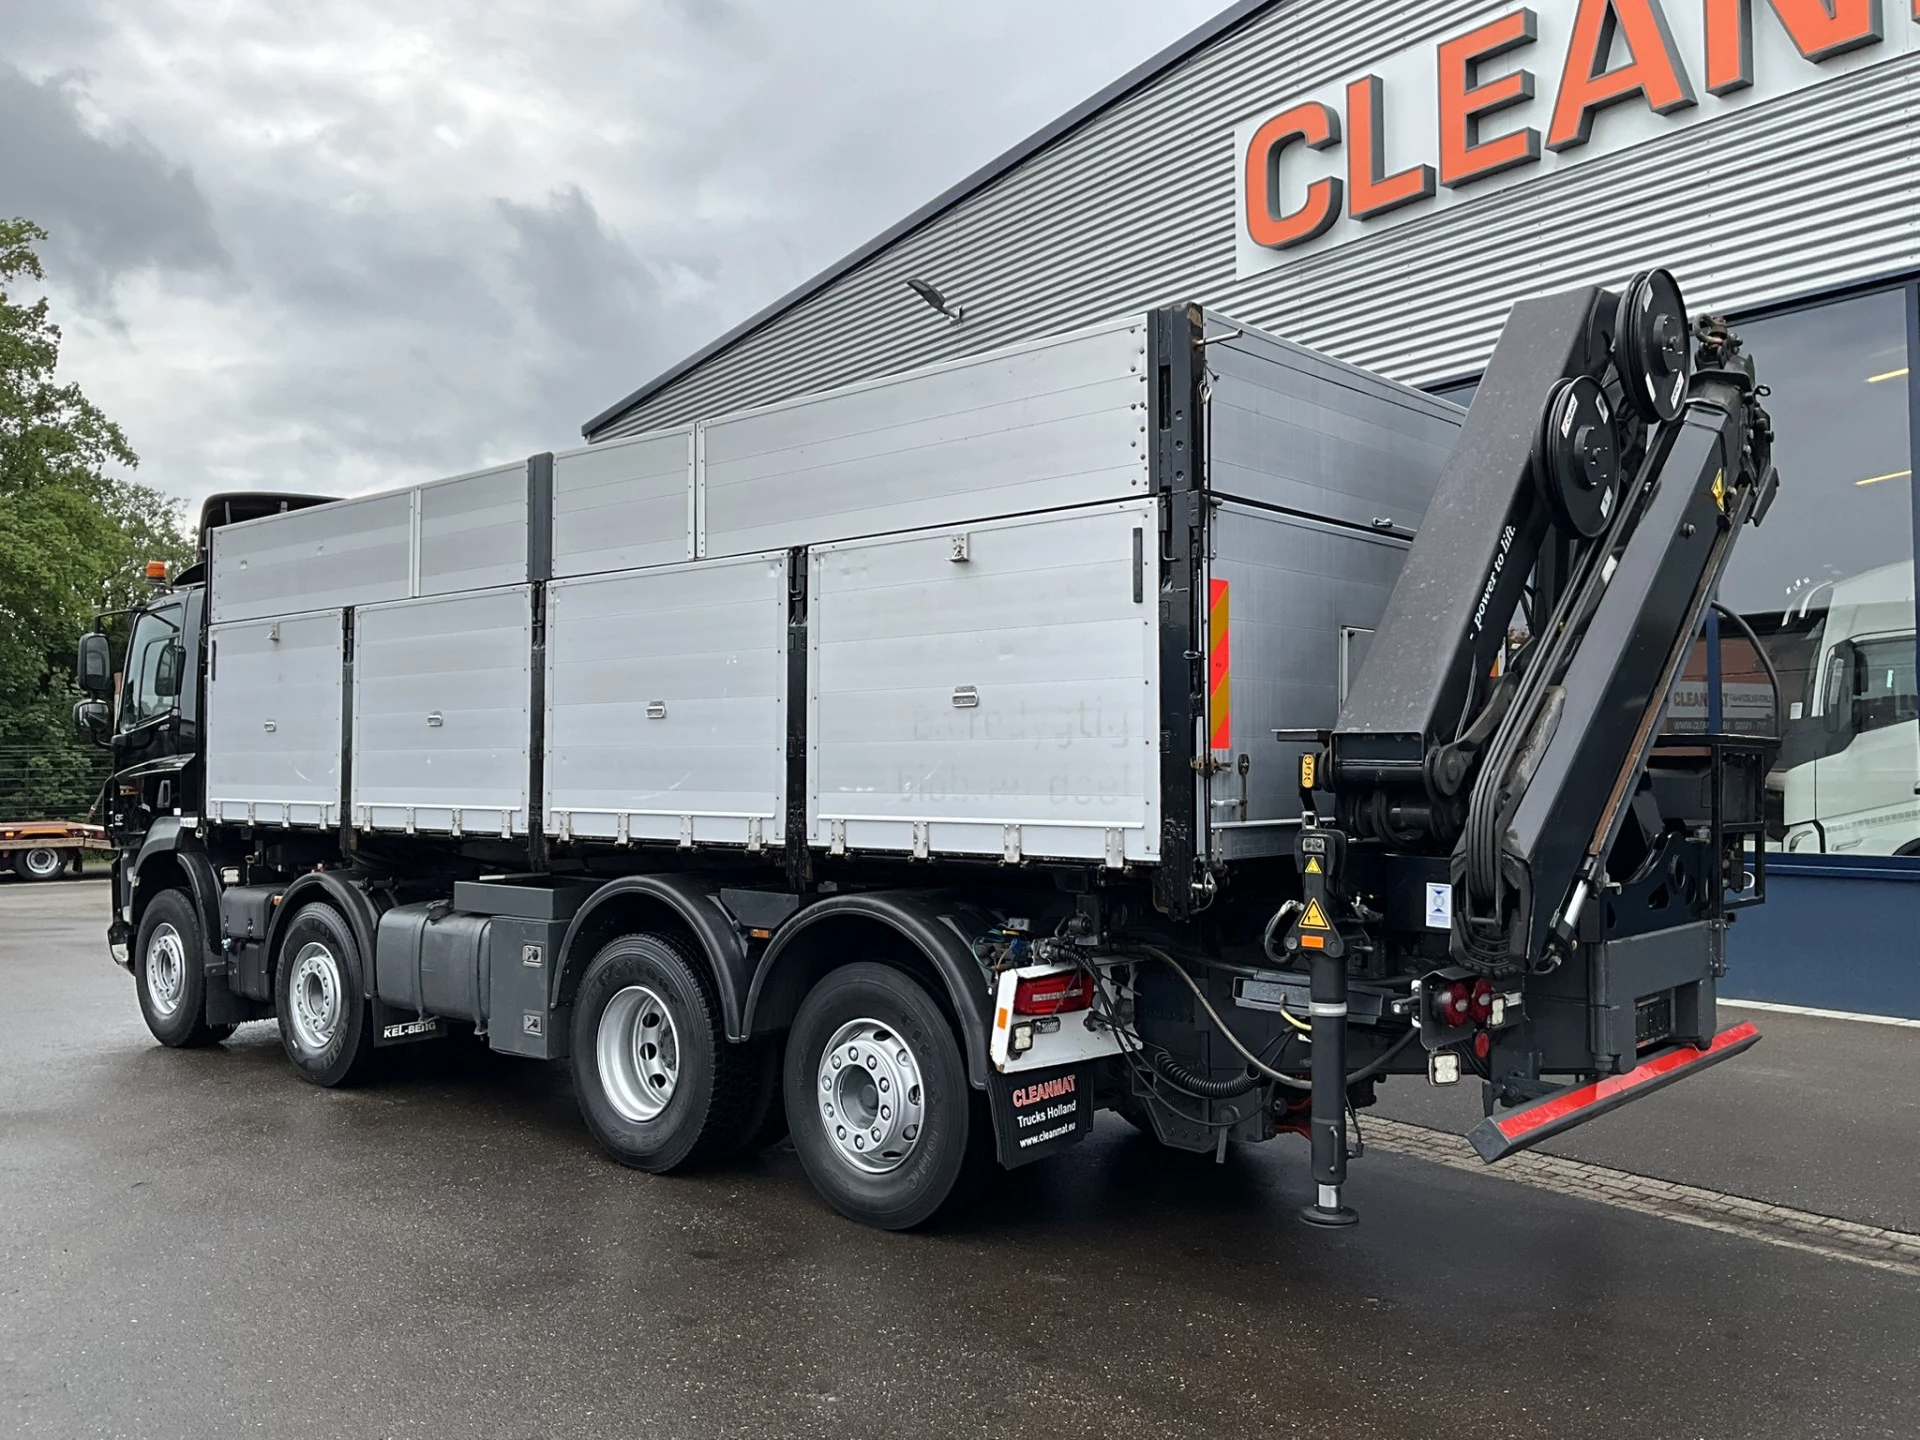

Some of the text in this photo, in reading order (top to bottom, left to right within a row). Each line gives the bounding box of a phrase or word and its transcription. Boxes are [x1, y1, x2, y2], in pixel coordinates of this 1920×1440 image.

[1474, 571, 1496, 631] power
[1494, 553, 1505, 572] to
[1012, 1074, 1076, 1108] CLEANMAT
[1016, 1099, 1077, 1128] Trucks Holland
[1019, 1122, 1076, 1148] www.cleanmat.eu
